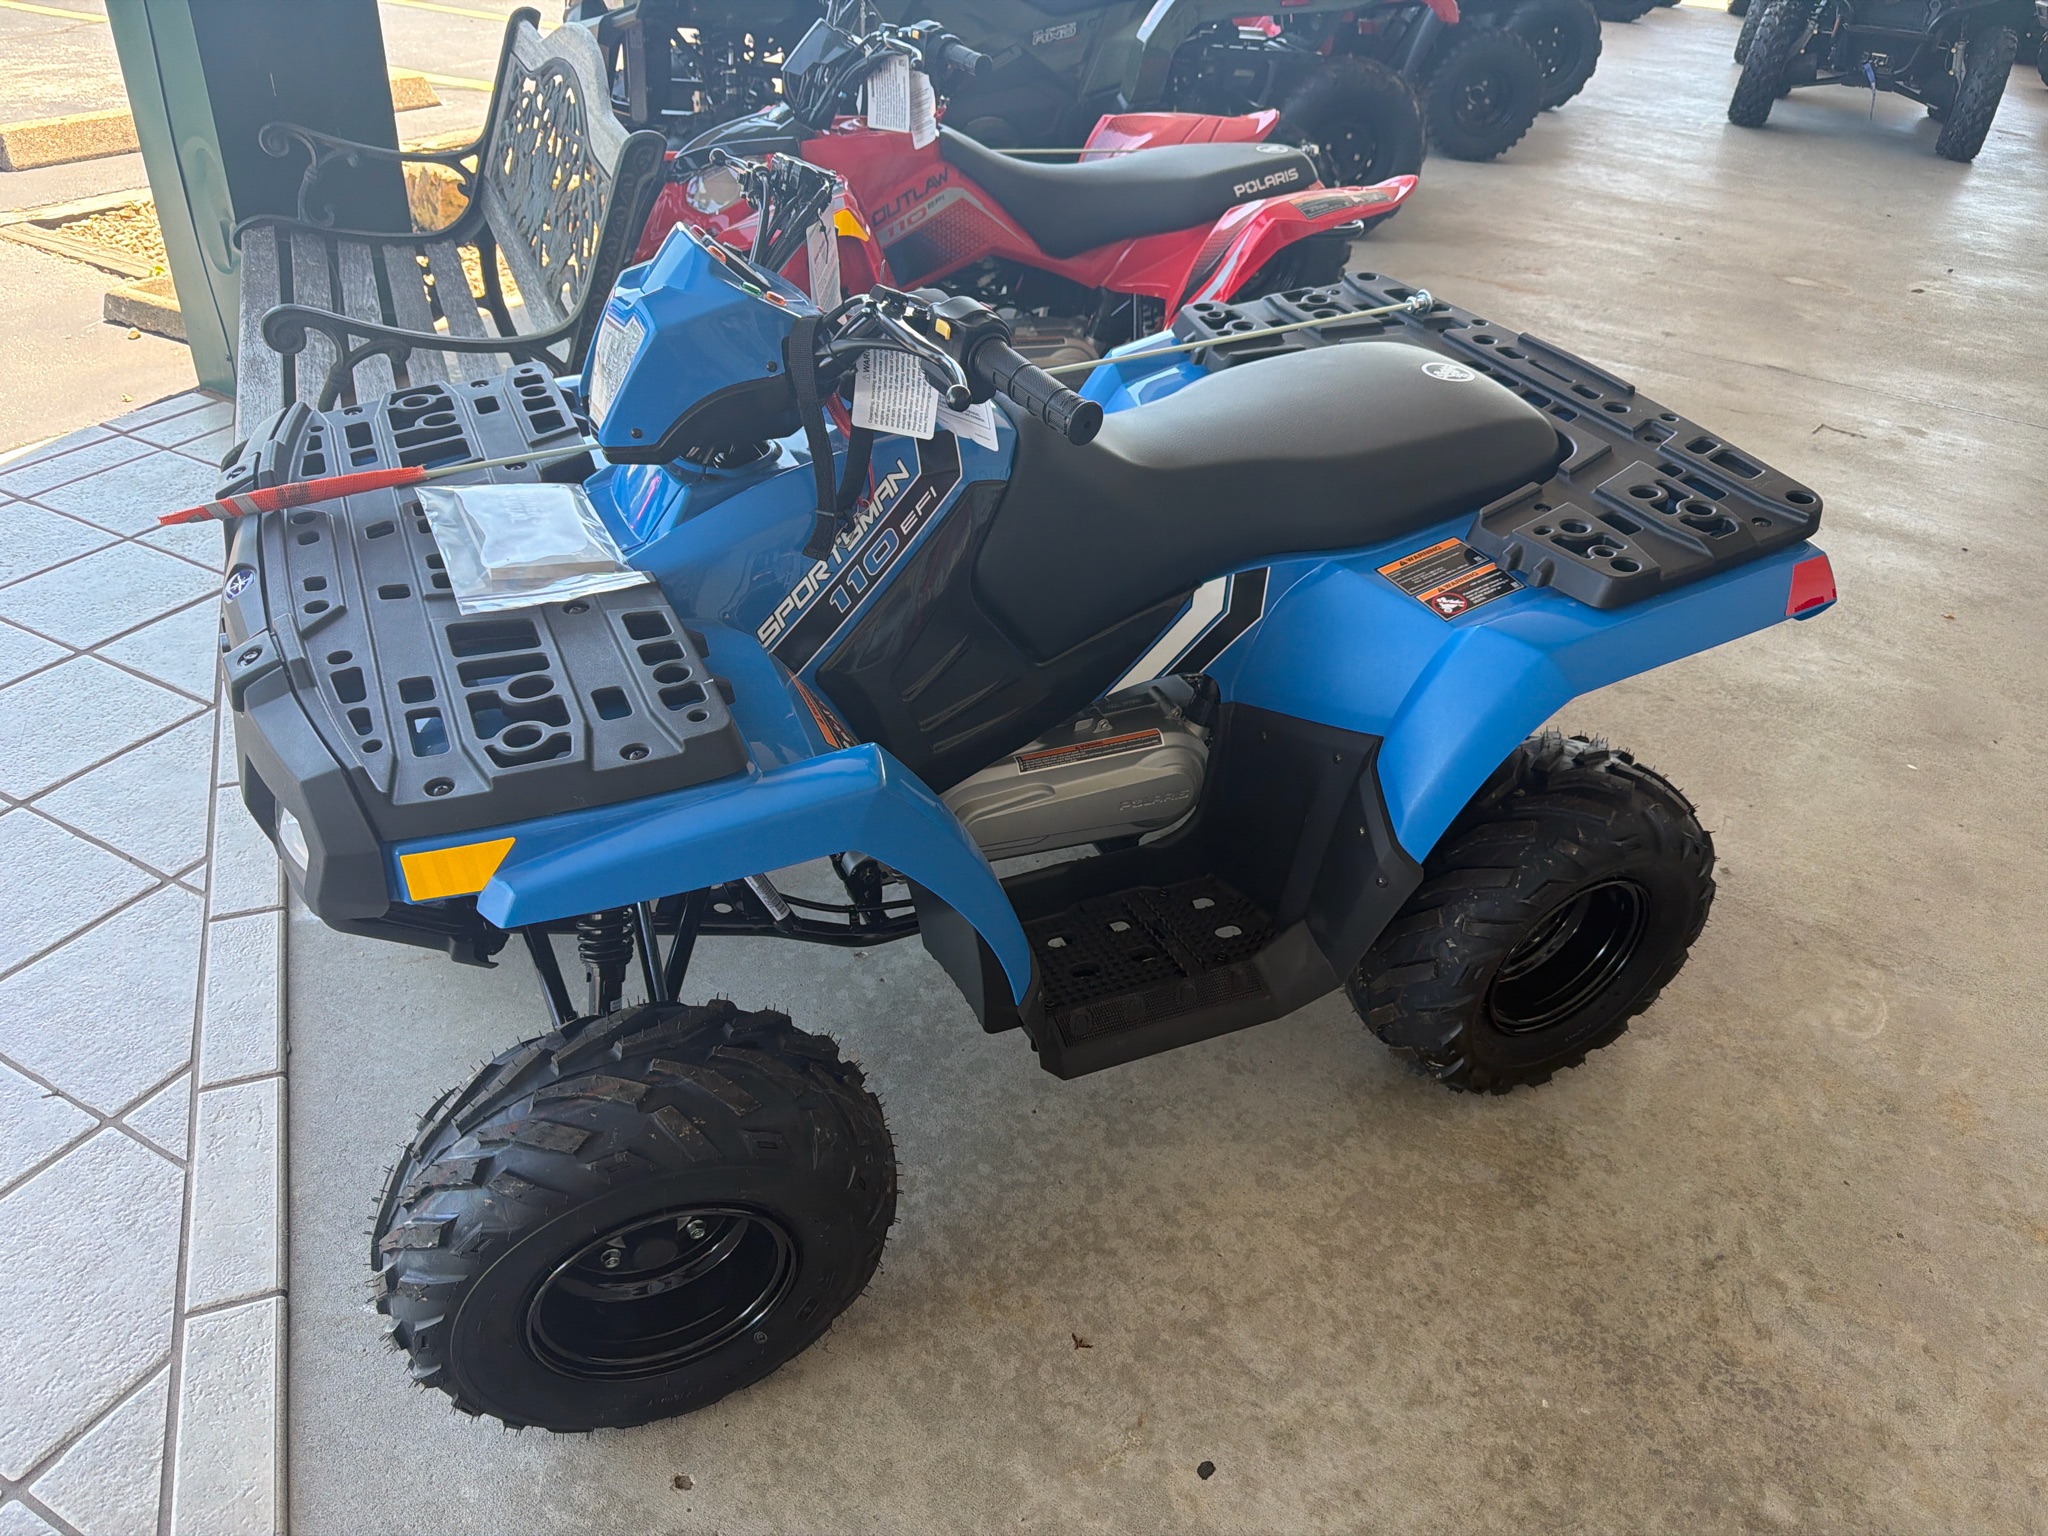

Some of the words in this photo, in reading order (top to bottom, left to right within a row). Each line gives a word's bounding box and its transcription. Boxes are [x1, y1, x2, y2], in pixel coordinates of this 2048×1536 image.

[871, 167, 948, 227] OUTLAW
[1232, 167, 1300, 198] POLARIS
[888, 206, 927, 238] 110
[927, 194, 945, 209] EFI
[756, 458, 910, 648] SPORTSMAN
[829, 527, 899, 613] 110
[900, 485, 937, 535] EFI
[1405, 545, 1442, 562] WARNING
[1444, 571, 1479, 589] WARNING
[1119, 789, 1190, 811] POLARIS
